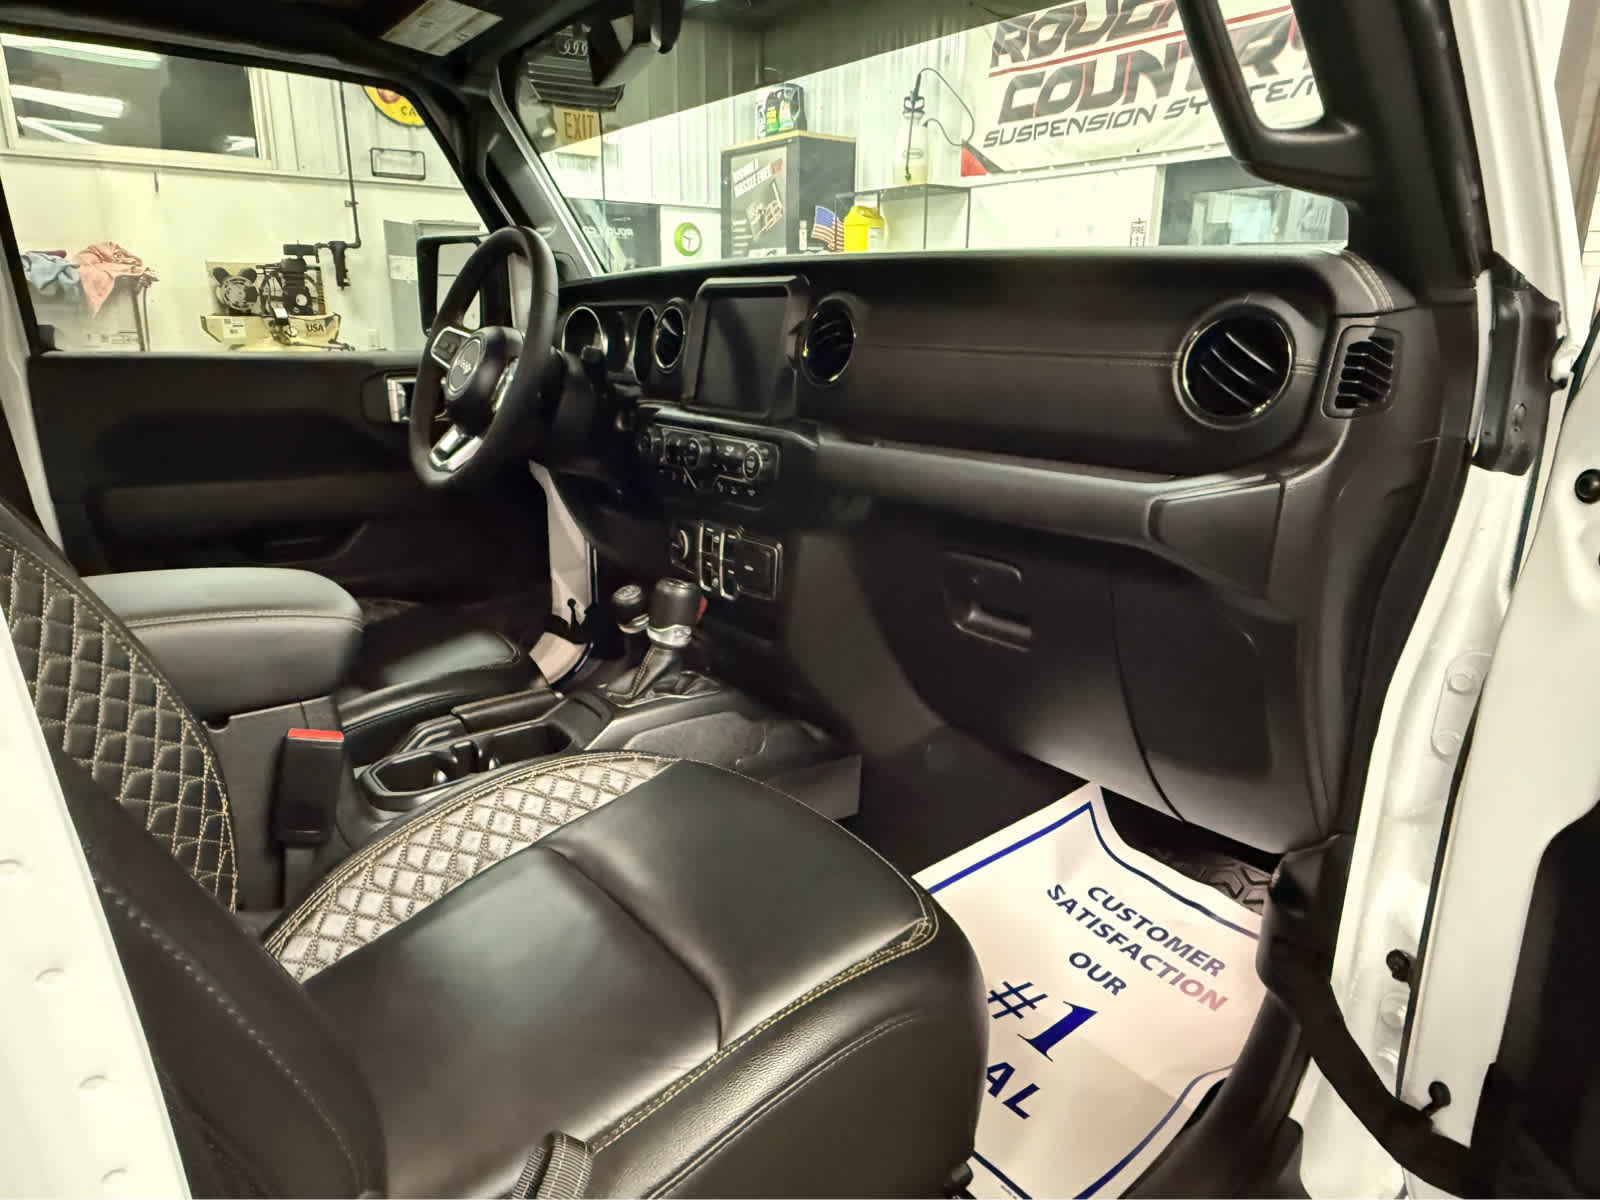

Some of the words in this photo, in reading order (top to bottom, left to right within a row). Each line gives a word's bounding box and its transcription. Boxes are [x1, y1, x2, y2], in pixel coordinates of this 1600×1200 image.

[990, 0, 1176, 67] ROUG
[564, 112, 594, 139] EXIT
[984, 104, 1157, 148] SUSPENSION
[306, 323, 324, 332] USA
[1047, 884, 1228, 1012] SATISFACTION
[1088, 886, 1226, 976] CUSTOMER
[1069, 951, 1127, 995] OUR
[987, 981, 1097, 1062] #1
